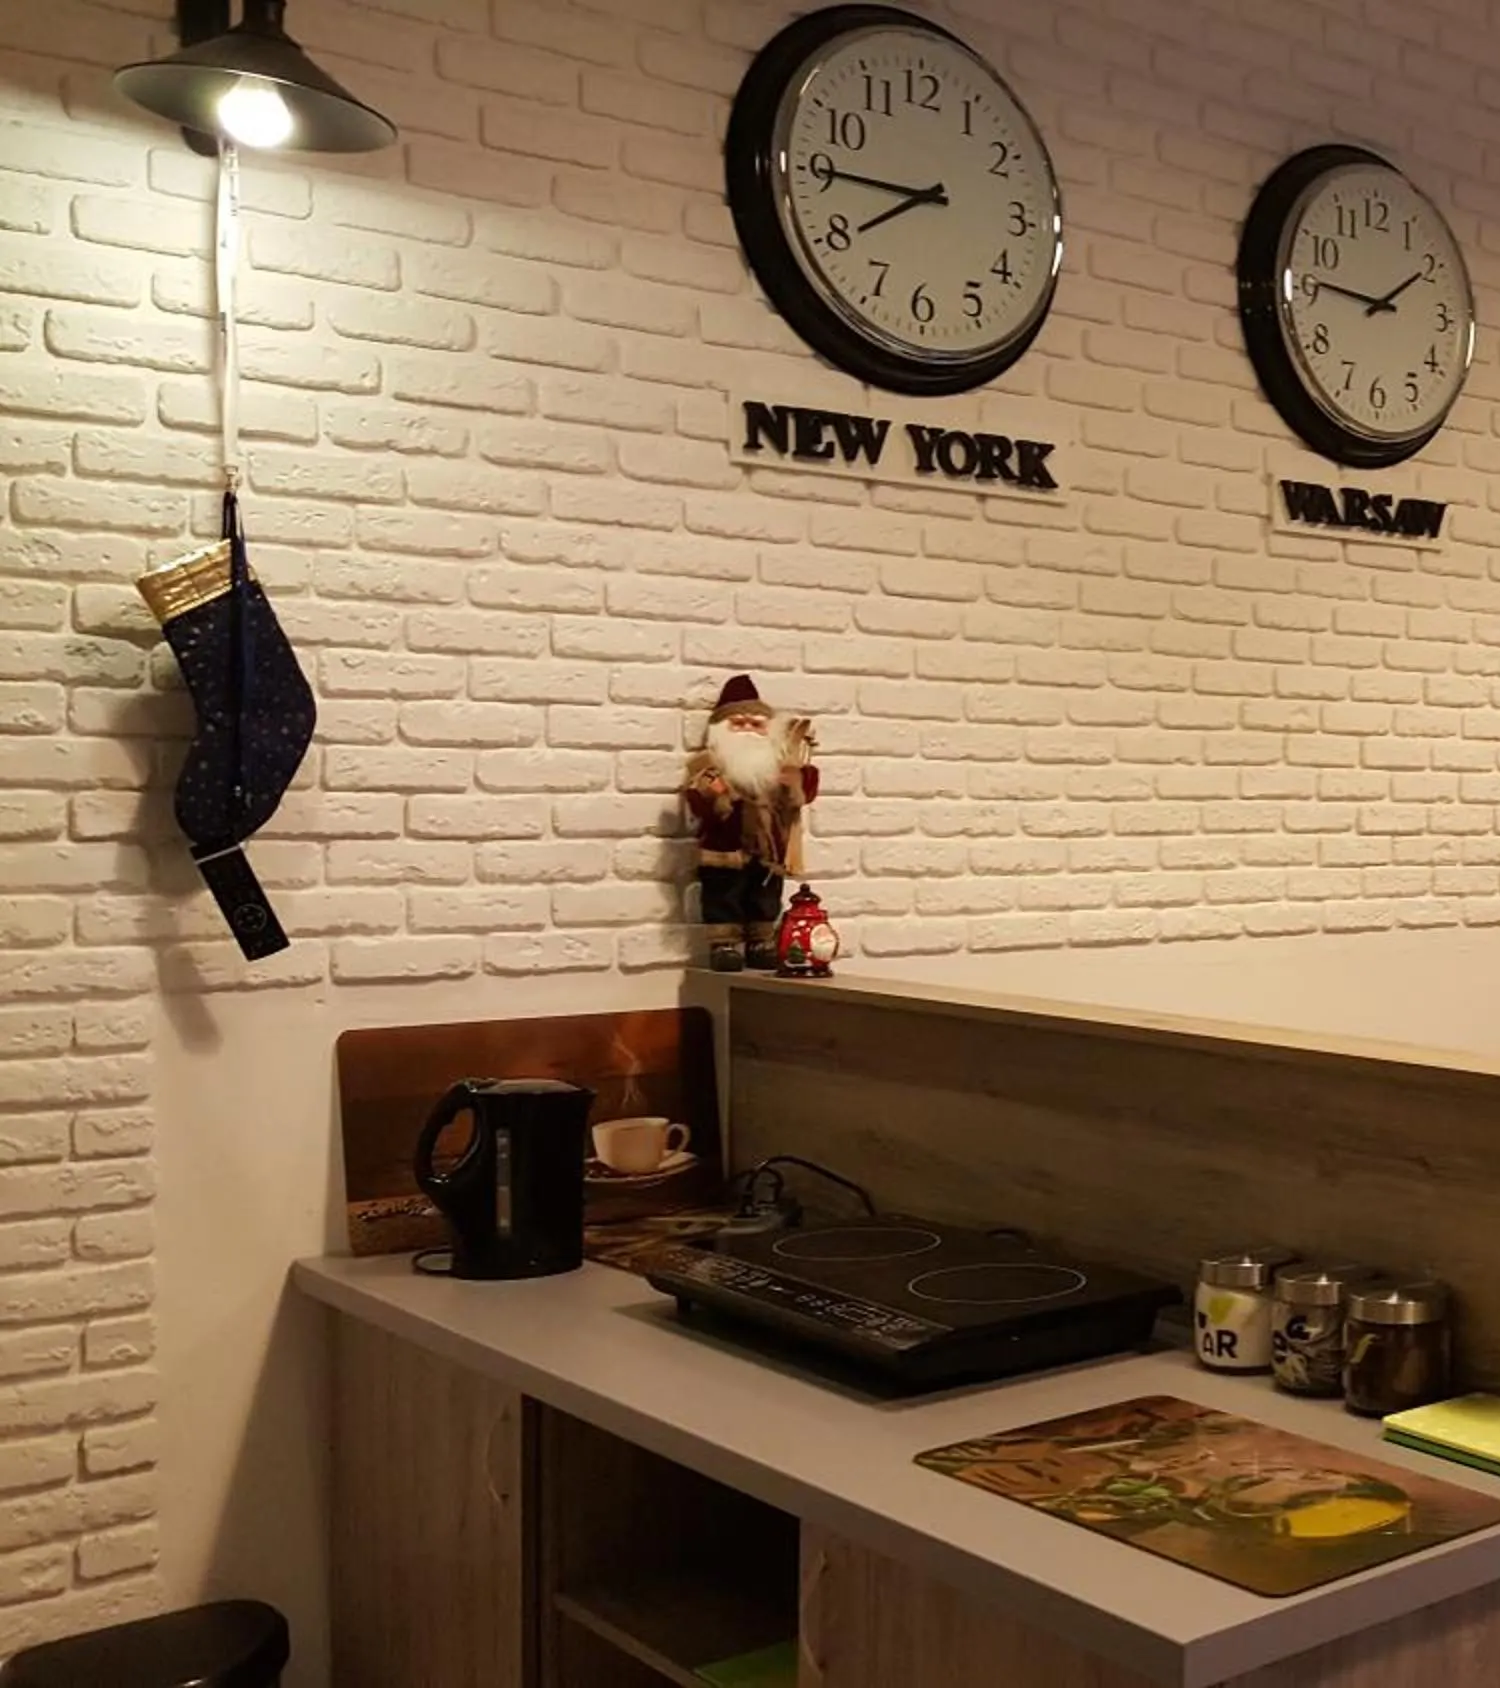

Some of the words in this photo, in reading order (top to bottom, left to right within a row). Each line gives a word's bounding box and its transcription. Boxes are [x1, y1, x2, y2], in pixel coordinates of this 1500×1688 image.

[863, 75, 893, 117] 11
[903, 69, 941, 112] 12
[827, 108, 866, 151] 10
[961, 99, 974, 136] 1
[810, 153, 835, 193] 9
[987, 141, 1010, 178] 2
[825, 214, 851, 251] 8
[1006, 201, 1026, 237] 3
[1336, 204, 1358, 240] 11
[1363, 199, 1389, 233] 12
[1312, 235, 1339, 271] 10
[1402, 220, 1412, 251] 1
[868, 259, 890, 297] 7
[990, 249, 1013, 285] 4
[1420, 253, 1436, 284] 2
[910, 282, 935, 323] 6
[961, 281, 983, 318] 5
[1302, 274, 1321, 306] 9
[1435, 303, 1449, 333] 3
[1312, 323, 1330, 355] 8
[1341, 360, 1356, 391] 7
[1424, 344, 1440, 373] 4
[1369, 376, 1387, 409] 6
[1404, 371, 1419, 404] 5
[743, 401, 892, 466] NEW
[904, 423, 1059, 490] YORK
[1279, 479, 1448, 539] WARSAW
